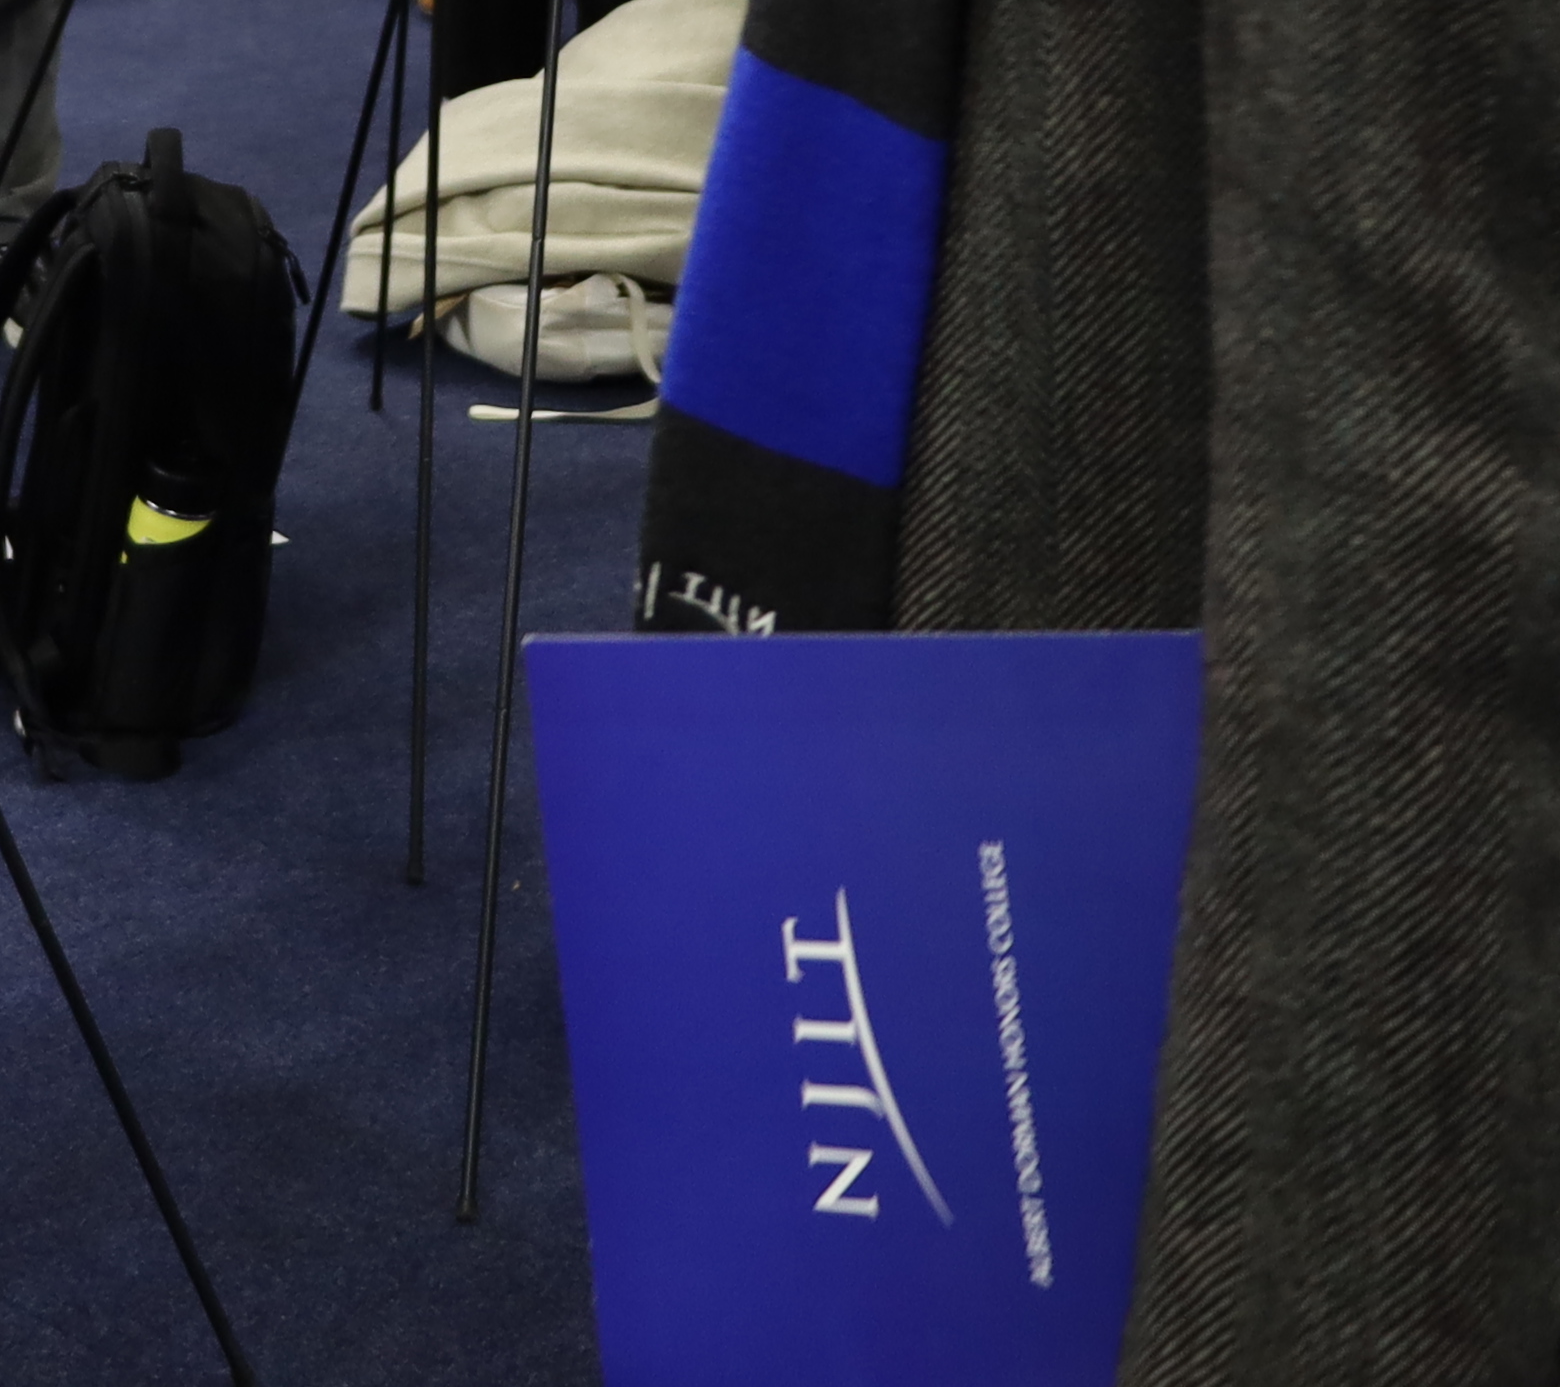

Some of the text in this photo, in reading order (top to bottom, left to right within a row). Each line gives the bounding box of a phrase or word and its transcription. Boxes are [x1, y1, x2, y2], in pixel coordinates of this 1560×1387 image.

[979, 841, 1014, 955] COLLEGE
[782, 917, 883, 1218] NJIT
[991, 956, 1025, 1070] HONORS
[1006, 1071, 1042, 1194] DORMAN
